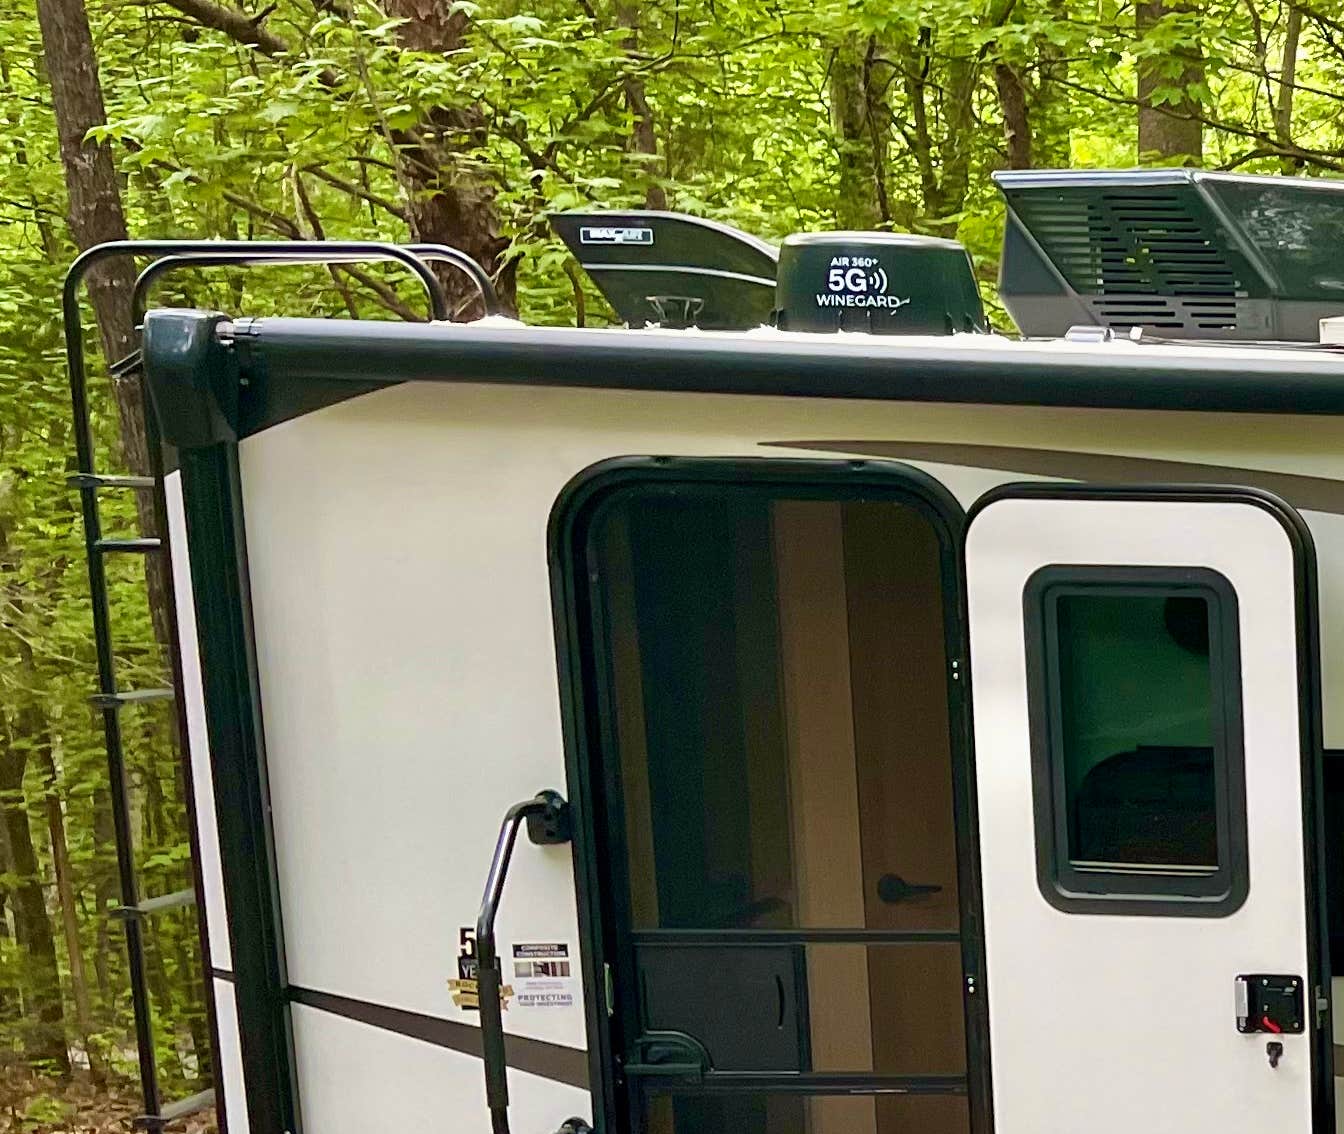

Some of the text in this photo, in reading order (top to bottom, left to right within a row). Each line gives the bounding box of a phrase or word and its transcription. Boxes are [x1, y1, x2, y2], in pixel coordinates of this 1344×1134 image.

[830, 257, 850, 266] AIR
[828, 268, 868, 292] 5G
[816, 294, 903, 308] WINEGARD
